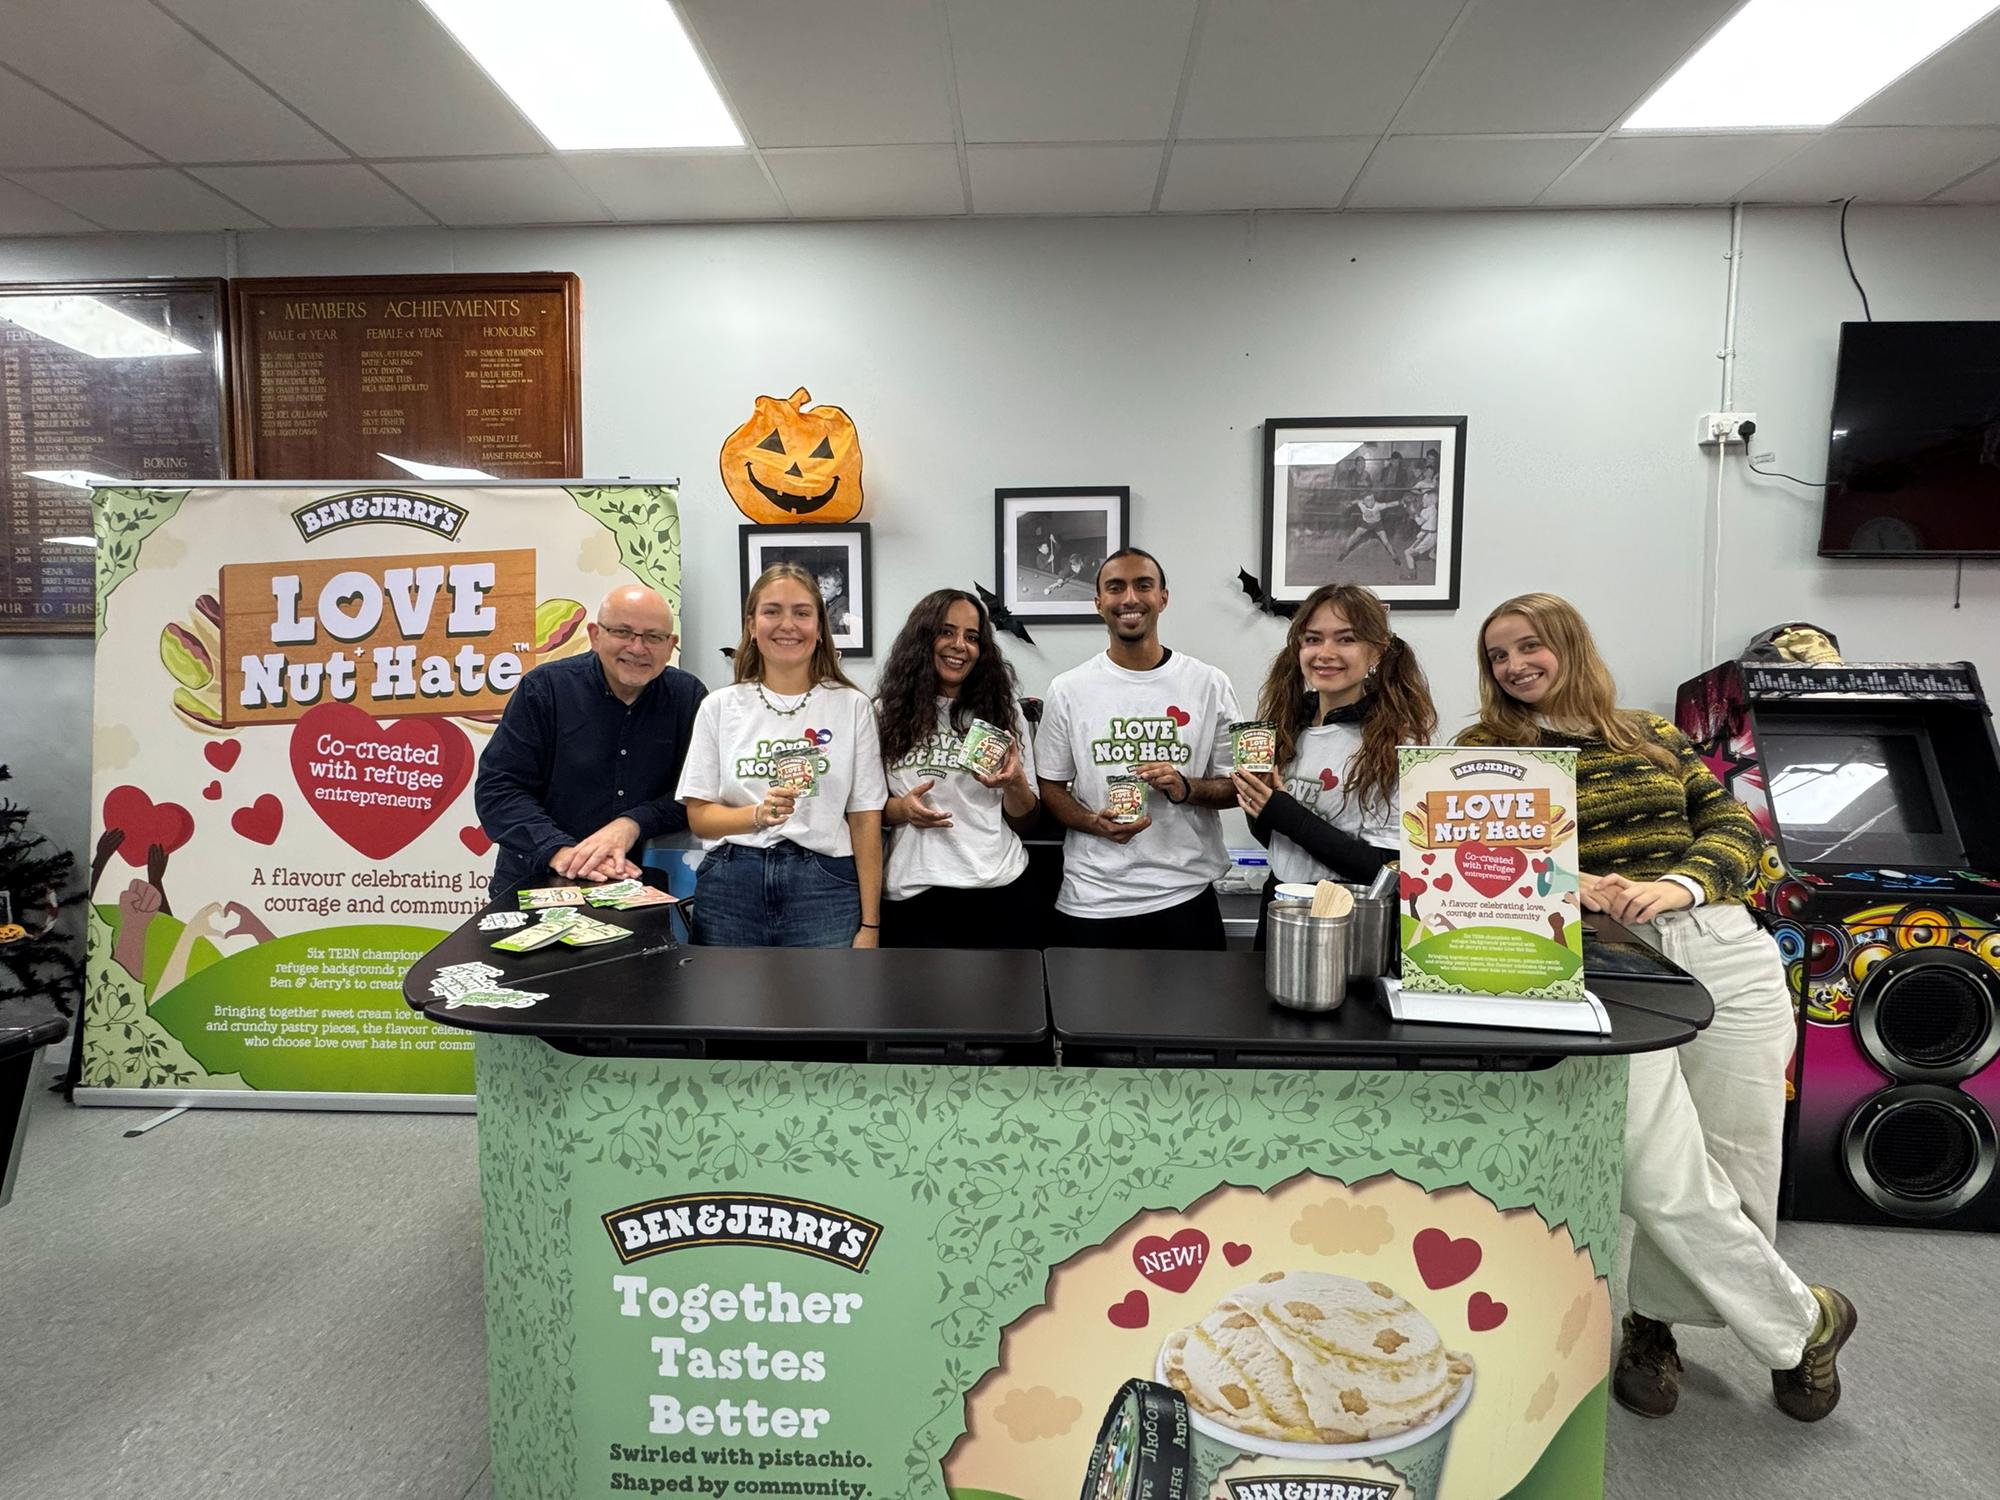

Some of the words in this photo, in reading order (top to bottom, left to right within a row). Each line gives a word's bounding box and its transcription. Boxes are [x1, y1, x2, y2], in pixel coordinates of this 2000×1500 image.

[285, 302, 367, 320] MEMBERS
[385, 300, 521, 318] ACHIEVMENTS
[268, 330, 295, 341] MALE
[308, 329, 338, 340] YEAR
[366, 328, 403, 339] FEMALE
[418, 327, 443, 338] YEAR
[483, 327, 536, 337] HONOURS
[506, 348, 544, 357] THOMPSON
[480, 408, 500, 416] JAMES
[502, 408, 522, 416] SCOTT
[143, 457, 188, 468] BOXING
[482, 452, 505, 460] MAISIE
[505, 451, 542, 459] FERGUSON
[41, 567, 74, 575] SENIOR
[0, 602, 23, 614] UR
[33, 602, 53, 614] TO
[62, 602, 95, 614] THIS
[271, 562, 496, 644] LOVE
[240, 651, 356, 708] Nut
[1113, 720, 1174, 740] LOVE
[316, 734, 440, 766] Co-created
[930, 749, 961, 768] Ha
[1094, 742, 1135, 762] Not
[1138, 742, 1189, 762] Hate
[309, 761, 357, 781] with
[364, 764, 444, 791] refugee
[738, 759, 777, 776] Not
[315, 787, 432, 810] entrepreneurs
[1285, 778, 1321, 803] OVE
[1446, 793, 1536, 820] LOVE
[1434, 822, 1480, 842] Nut
[1486, 820, 1547, 840] Hate
[1464, 851, 1514, 865] Co-created
[1462, 860, 1482, 870] with
[1484, 862, 1516, 874] refugee
[1464, 870, 1512, 881] entrepreneurs
[251, 868, 266, 886] A
[272, 868, 346, 887] flavour
[351, 870, 463, 892] celebrating
[468, 871, 495, 889] lo
[264, 896, 341, 916] courage
[347, 895, 385, 915] and
[390, 897, 488, 915] communit
[1449, 900, 1478, 908] flavour
[1479, 901, 1525, 912] celebrating
[1526, 903, 1546, 912] love,
[1446, 910, 1476, 918] courage
[1478, 910, 1494, 918] and
[1495, 911, 1540, 921] community
[306, 948, 325, 960] Six
[328, 949, 360, 960] TERN
[275, 963, 319, 976] refugee
[322, 963, 394, 977] backgrounds
[269, 977, 292, 988] Ben
[309, 977, 351, 991] Jerry's
[355, 979, 367, 989] to
[214, 1005, 266, 1019] Bringing
[269, 1006, 318, 1020] together
[321, 1008, 354, 1019] sweet
[357, 1011, 392, 1020] cream
[395, 1009, 411, 1020] ice
[206, 1021, 228, 1032] and
[230, 1021, 278, 1035] crunchy
[281, 1023, 319, 1035] pastry
[322, 1023, 360, 1035] pieces,
[363, 1024, 383, 1034] the
[385, 1024, 427, 1035] flavour
[431, 1025, 473, 1036] celebra
[244, 1036, 269, 1047] who
[272, 1037, 311, 1048] choose
[314, 1037, 339, 1048] love
[341, 1039, 367, 1049] over
[371, 1038, 397, 1049] hate
[399, 1038, 412, 1049] in
[415, 1040, 436, 1049] our
[1140, 1243, 1204, 1275] NEW!
[613, 1275, 863, 1333] Together
[651, 1336, 826, 1382] Tastes
[649, 1394, 831, 1438] Better
[610, 1443, 697, 1464] Swirled
[701, 1447, 753, 1466] with
[758, 1448, 873, 1469] pistachio.
[610, 1473, 694, 1494] Shaped
[698, 1476, 729, 1498] by
[734, 1476, 873, 1500] community.
